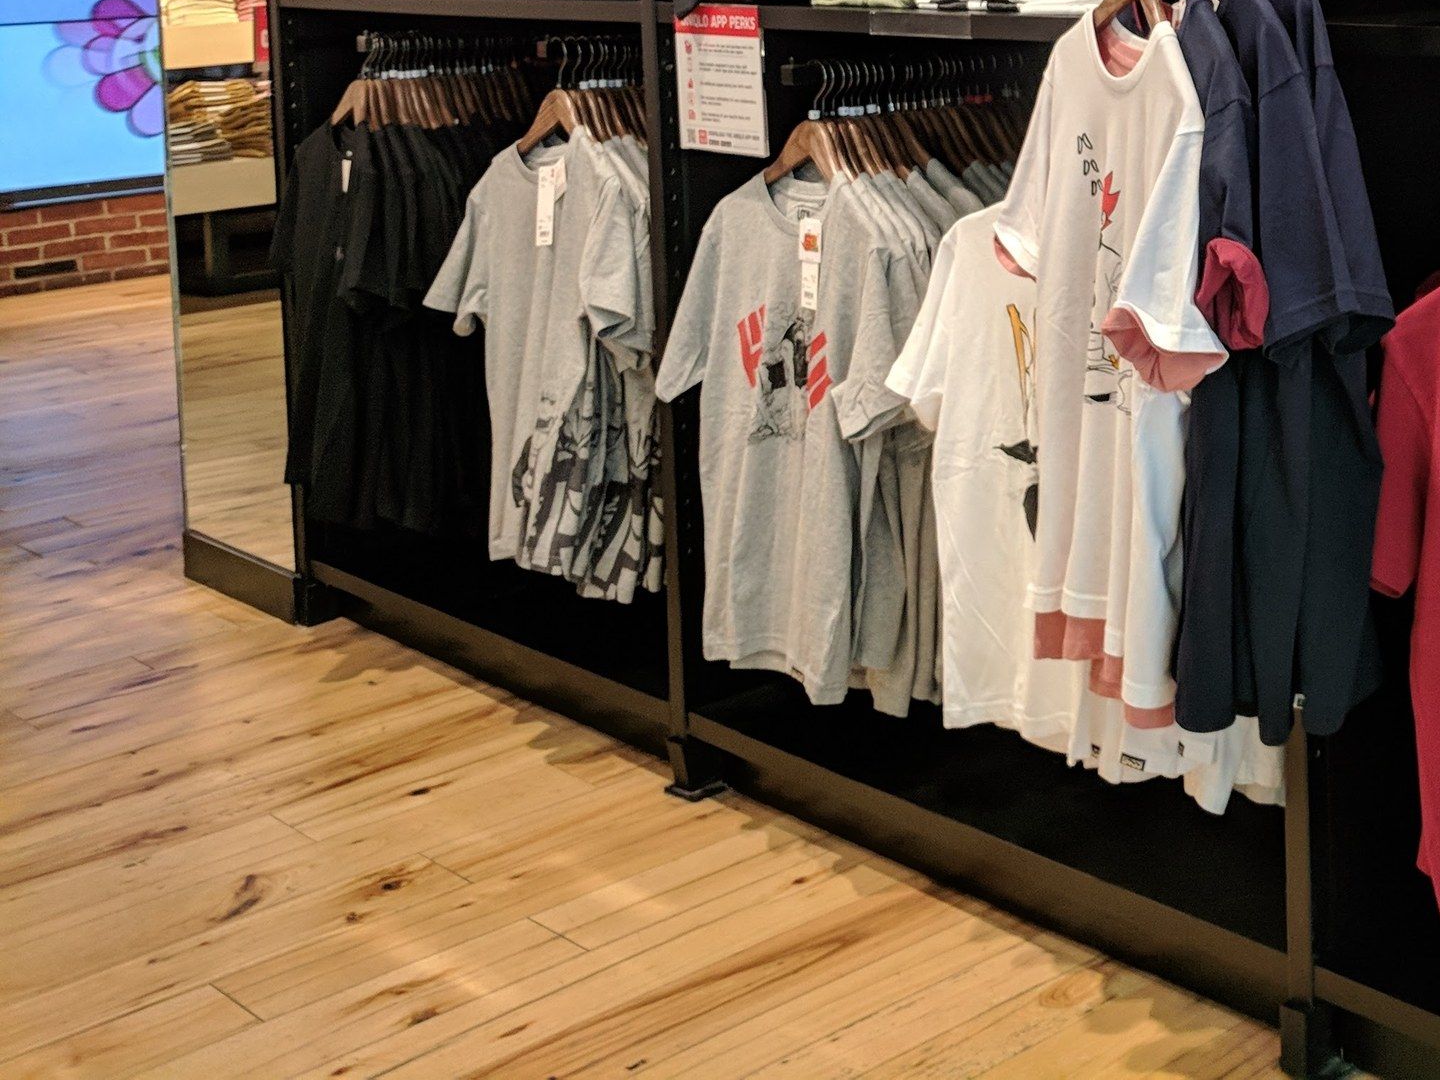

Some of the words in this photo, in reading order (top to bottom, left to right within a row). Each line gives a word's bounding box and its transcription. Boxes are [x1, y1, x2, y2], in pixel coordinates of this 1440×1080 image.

[681, 15, 709, 28] NIQLO
[710, 15, 728, 29] APP
[729, 15, 756, 31] PERKS
